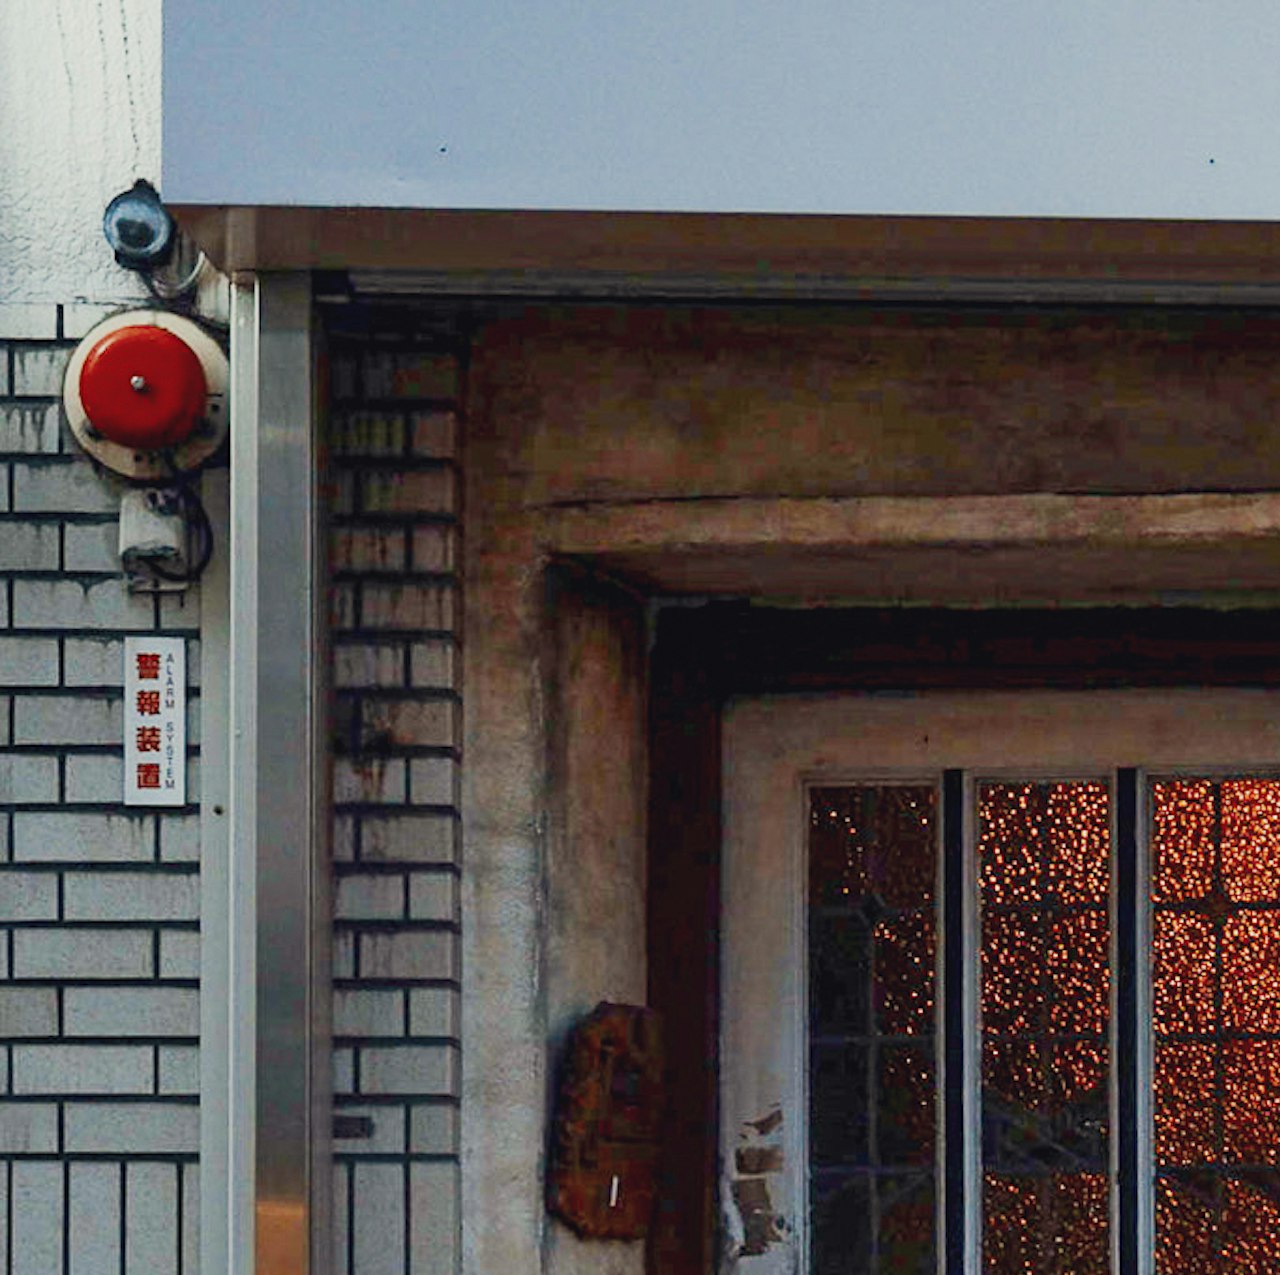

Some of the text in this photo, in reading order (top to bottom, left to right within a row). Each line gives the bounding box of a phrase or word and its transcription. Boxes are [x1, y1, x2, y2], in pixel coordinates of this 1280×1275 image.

[136, 653, 161, 789] 警報装置
[165, 653, 175, 789] ALARM SYSTEM
